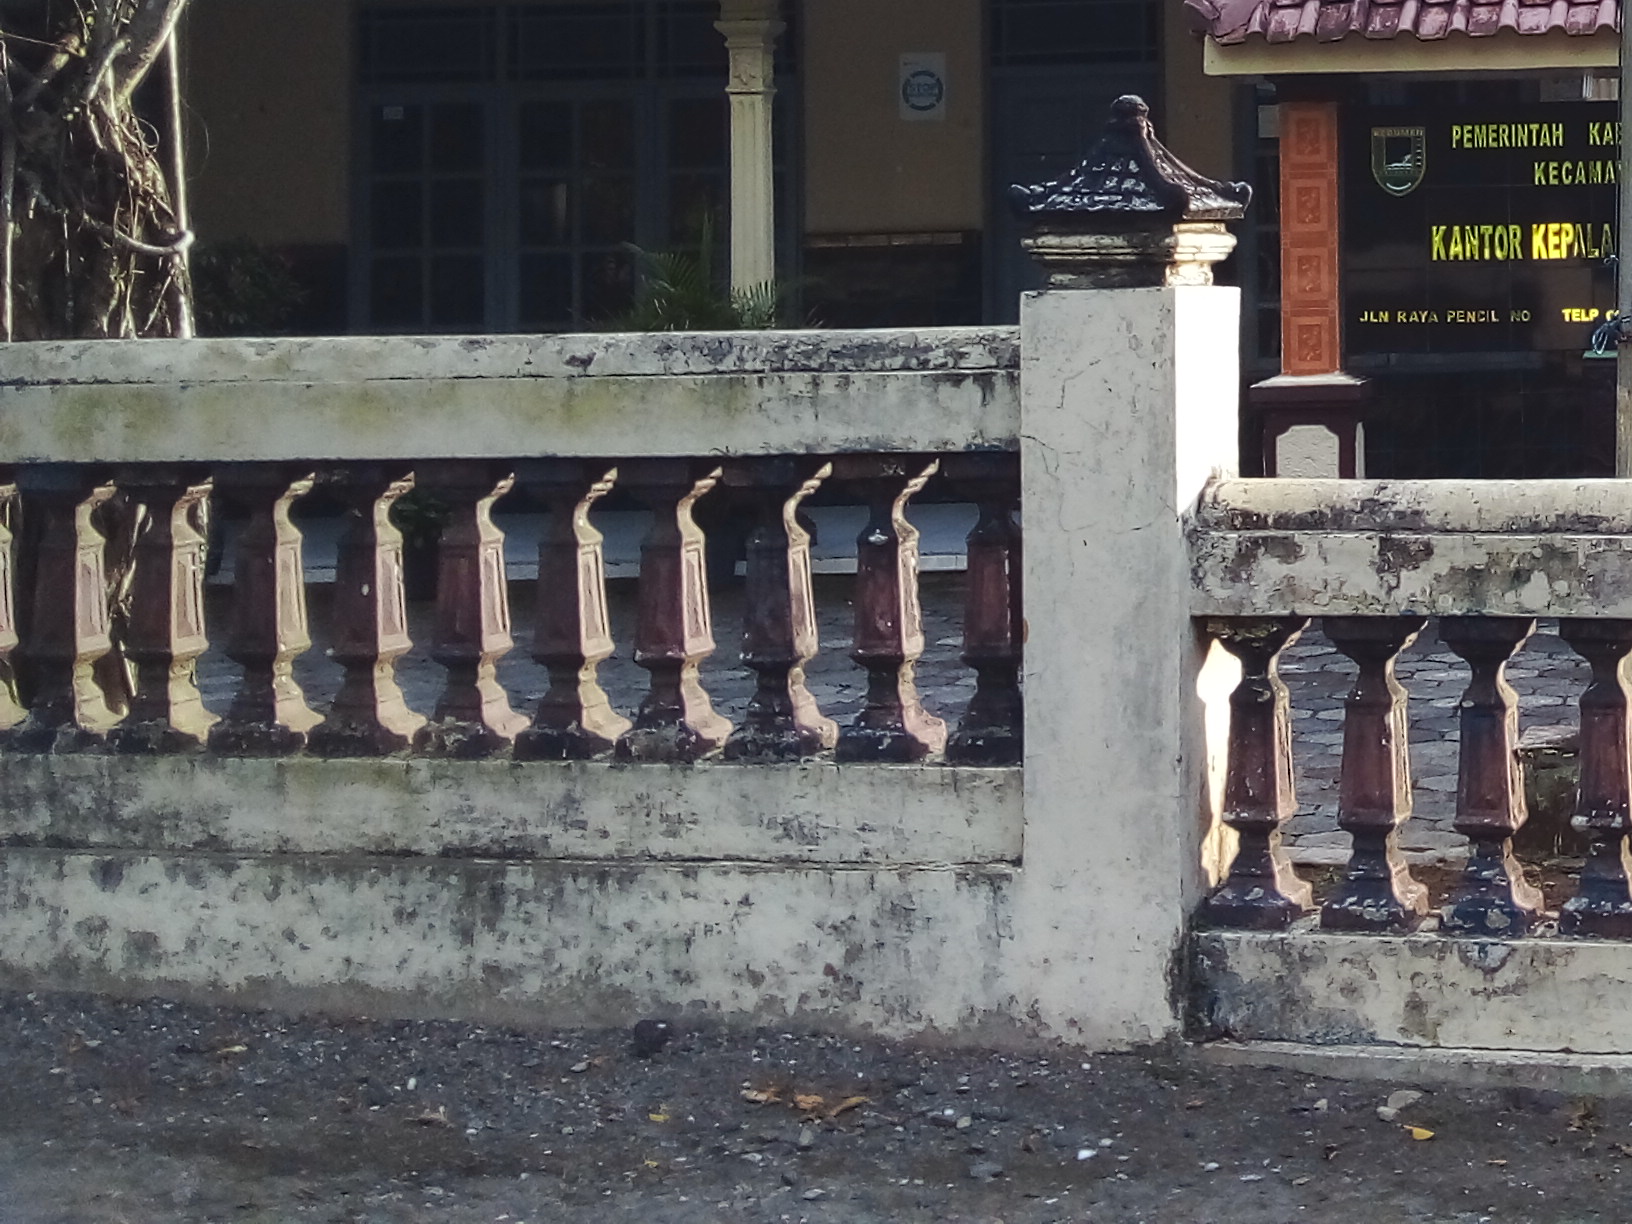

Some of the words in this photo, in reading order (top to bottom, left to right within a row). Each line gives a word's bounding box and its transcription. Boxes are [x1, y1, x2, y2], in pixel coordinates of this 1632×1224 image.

[1451, 123, 1564, 148] PEMERINTAH
[1431, 224, 1524, 261] KANTOR
[1531, 222, 1616, 260] KEPALA
[1359, 310, 1389, 323] JLN
[1396, 310, 1439, 323] RAYA
[1446, 309, 1500, 323] PENCIL
[1510, 309, 1532, 322] NO
[1562, 308, 1599, 322] TELP
